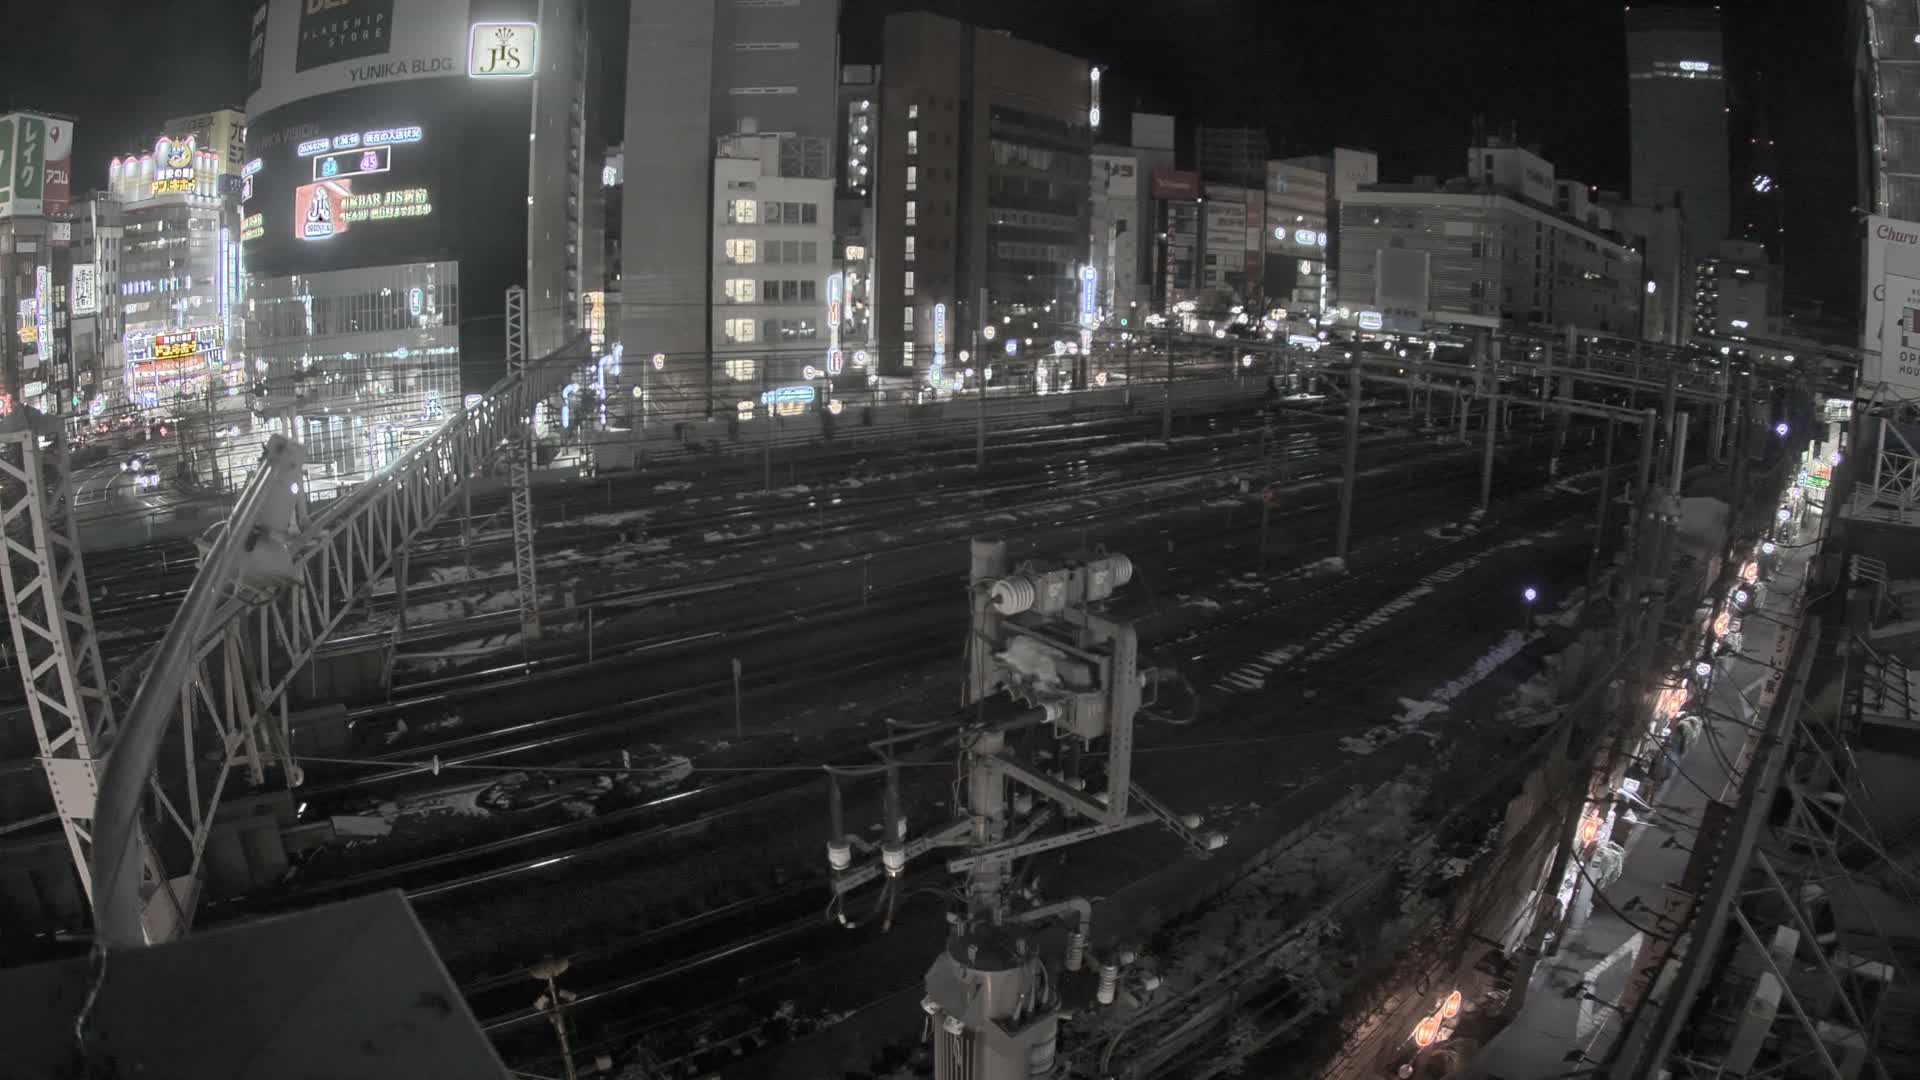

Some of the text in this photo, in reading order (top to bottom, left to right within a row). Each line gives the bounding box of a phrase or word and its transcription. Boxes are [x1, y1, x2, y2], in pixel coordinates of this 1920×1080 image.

[303, 13, 384, 41] FLAGSHIP
[328, 27, 384, 48] STORE
[350, 62, 408, 81] YUNIKA
[21, 120, 37, 188] レイク
[46, 169, 69, 185] アコム
